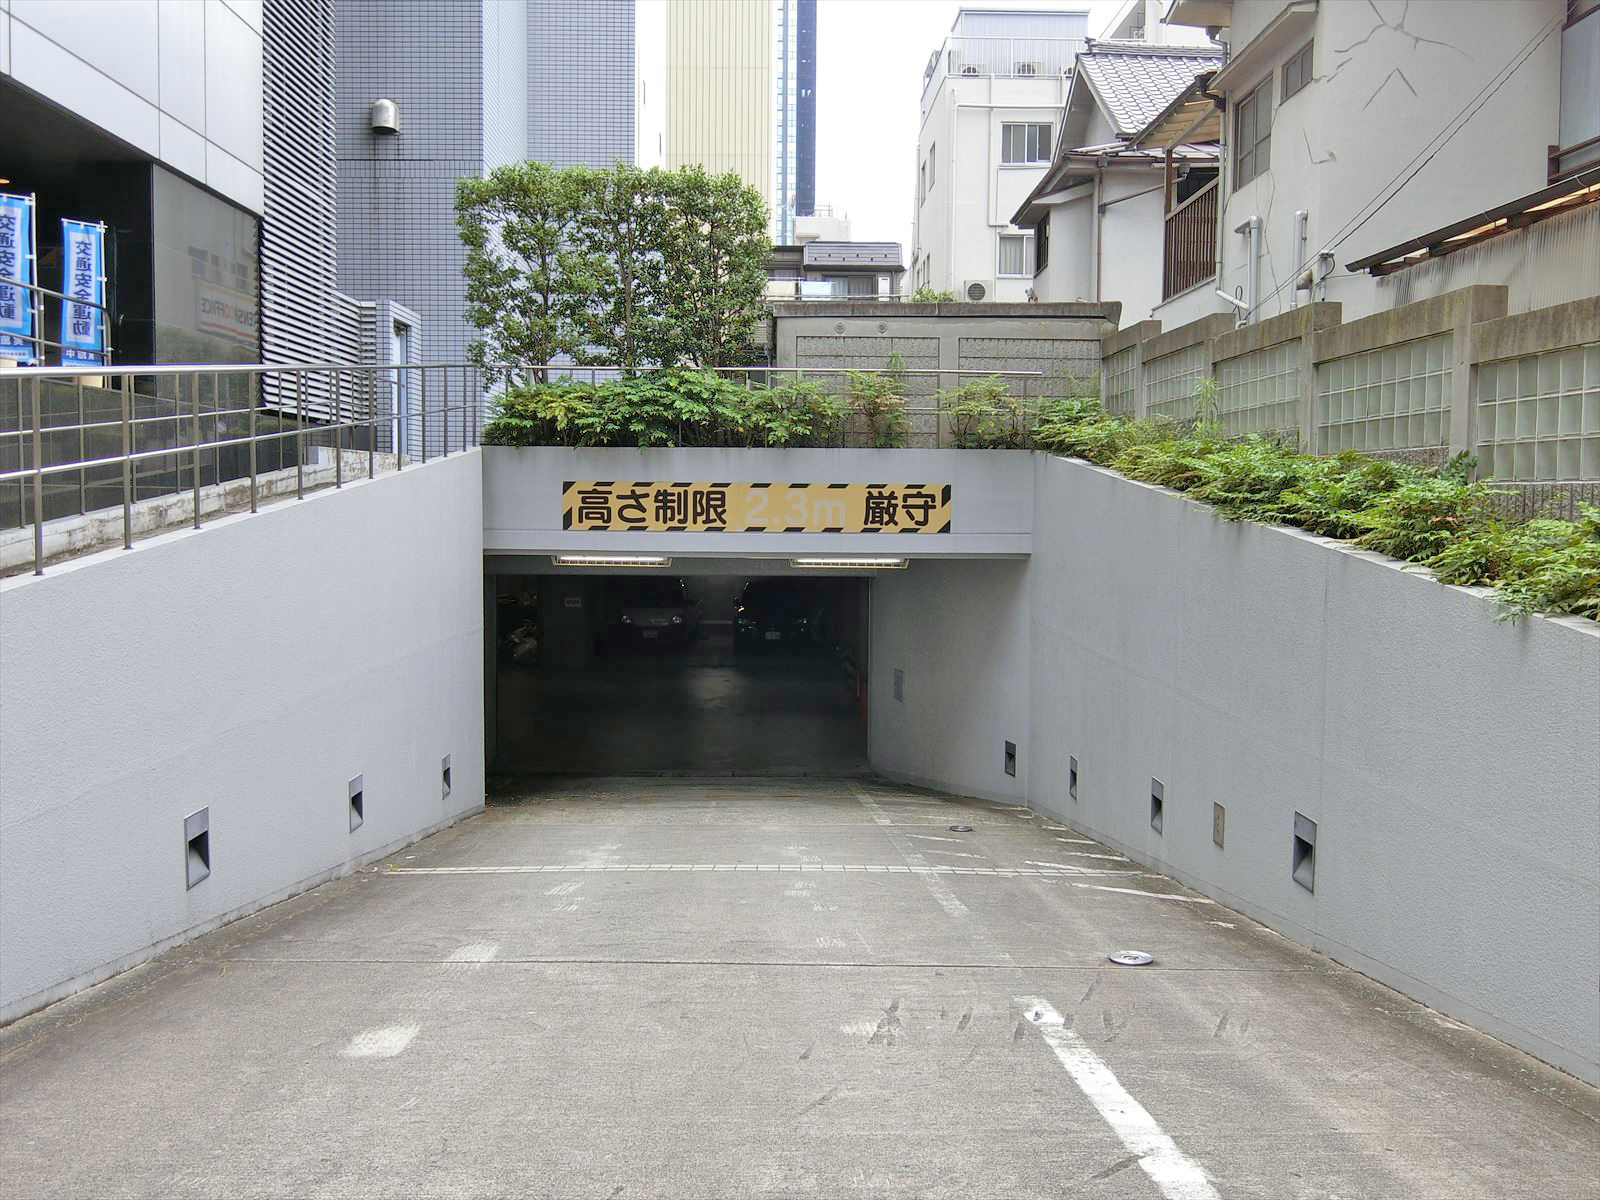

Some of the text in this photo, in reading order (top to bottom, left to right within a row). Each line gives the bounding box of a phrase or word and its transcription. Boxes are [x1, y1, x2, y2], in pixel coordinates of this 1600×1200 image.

[577, 488, 937, 527] 高さ制限 2.3m 厳守
